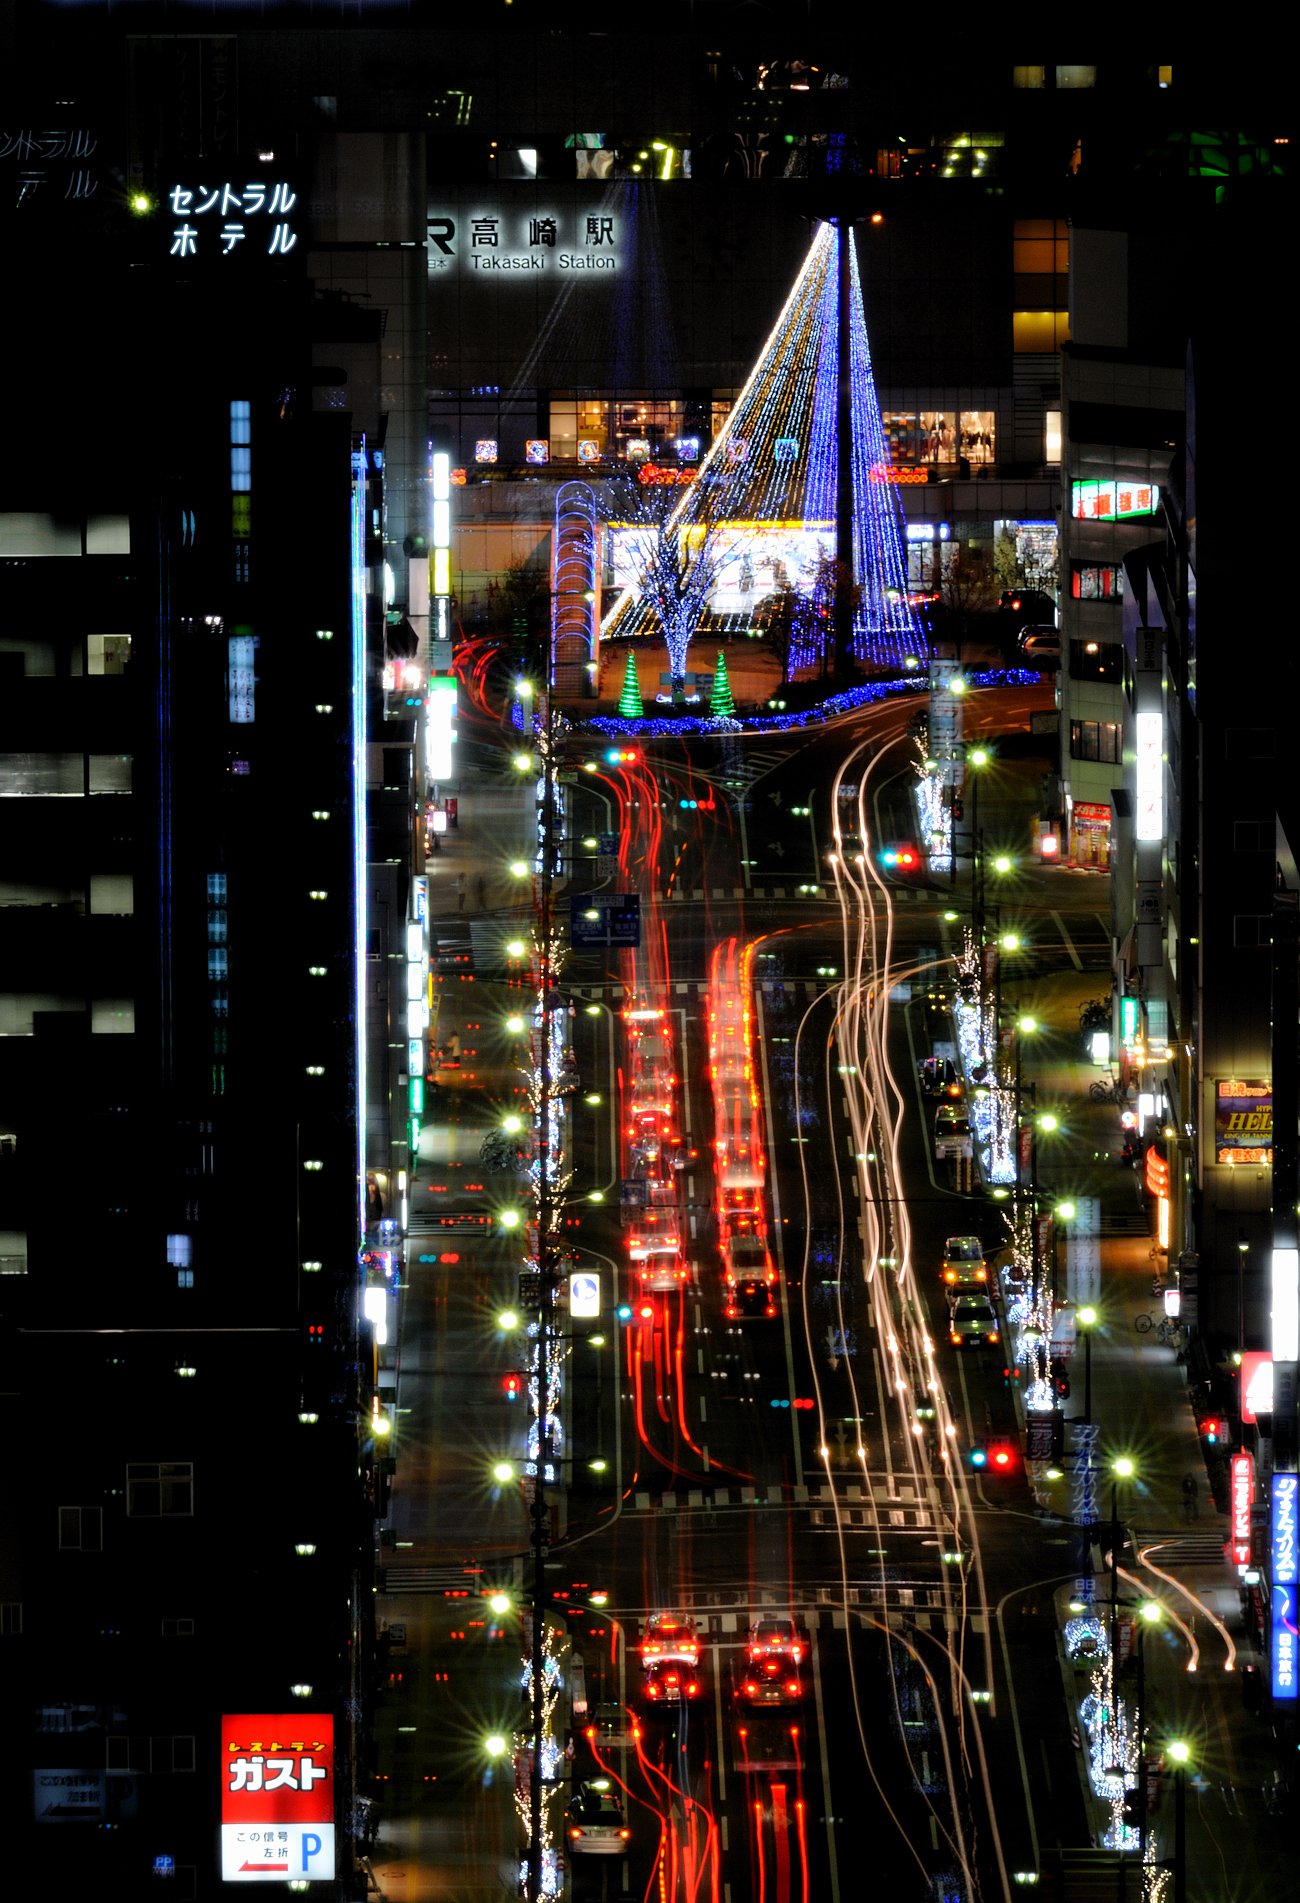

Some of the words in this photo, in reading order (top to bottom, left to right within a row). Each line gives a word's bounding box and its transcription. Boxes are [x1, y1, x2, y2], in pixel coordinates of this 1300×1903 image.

[169, 182, 297, 216] セントラル
[169, 223, 297, 257] ホテル
[427, 218, 456, 255] R
[471, 216, 615, 248] 高崎駅
[428, 258, 448, 270] 日本
[471, 255, 545, 270] Takasaki
[559, 254, 616, 270] Station
[1256, 1105, 1272, 1113] HYP
[1227, 1112, 1273, 1131] HEL
[228, 1742, 326, 1752] レストラン
[229, 1756, 327, 1792] ガスト
[237, 1831, 288, 1842] この信号
[302, 1833, 322, 1871] P
[264, 1847, 288, 1858] 左折
